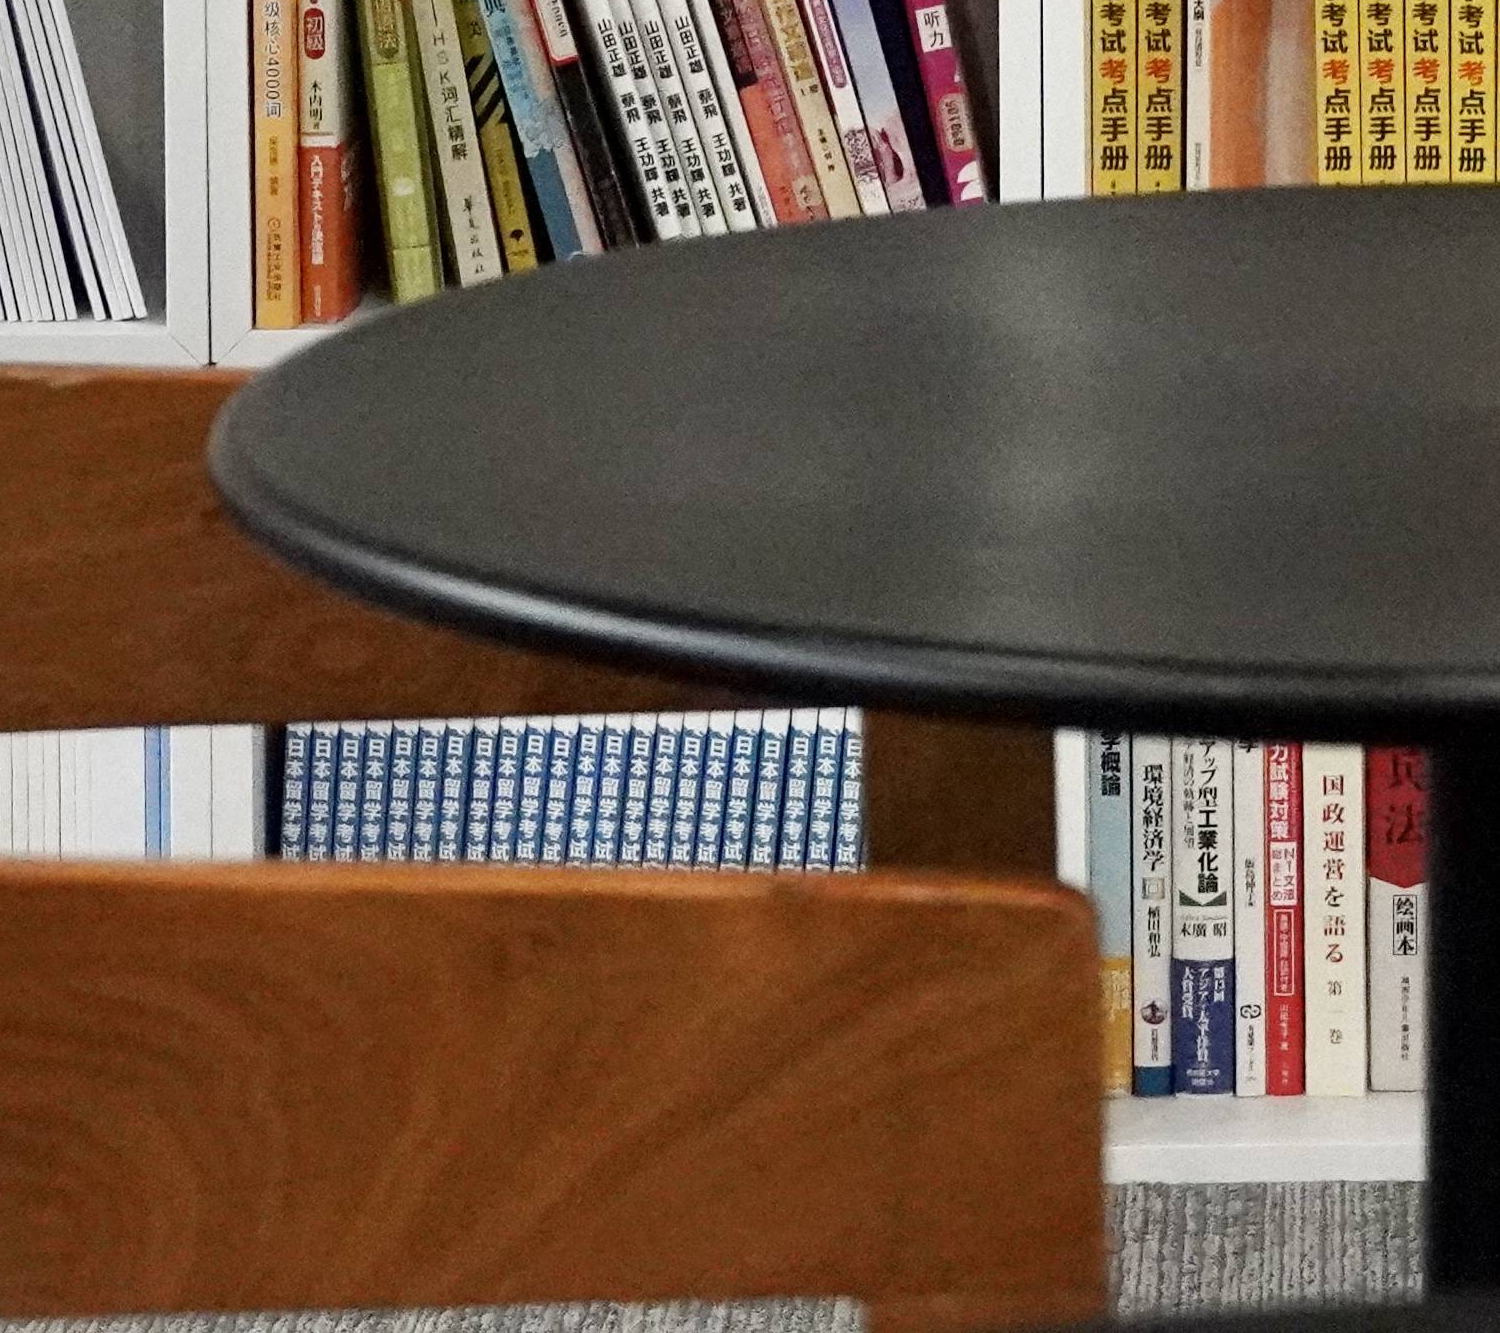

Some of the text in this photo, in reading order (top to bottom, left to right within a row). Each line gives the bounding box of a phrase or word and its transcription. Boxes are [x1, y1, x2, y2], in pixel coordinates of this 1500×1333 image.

[922, 11, 947, 50] 听力
[387, 736, 412, 861] 日本留学考试
[467, 738, 493, 861] 日本留学考试
[595, 736, 622, 859] 日本留学考试
[1142, 764, 1165, 872] 環境経済学
[1322, 773, 1346, 964] 国政運営を語る
[1395, 896, 1416, 954] 绘画本
